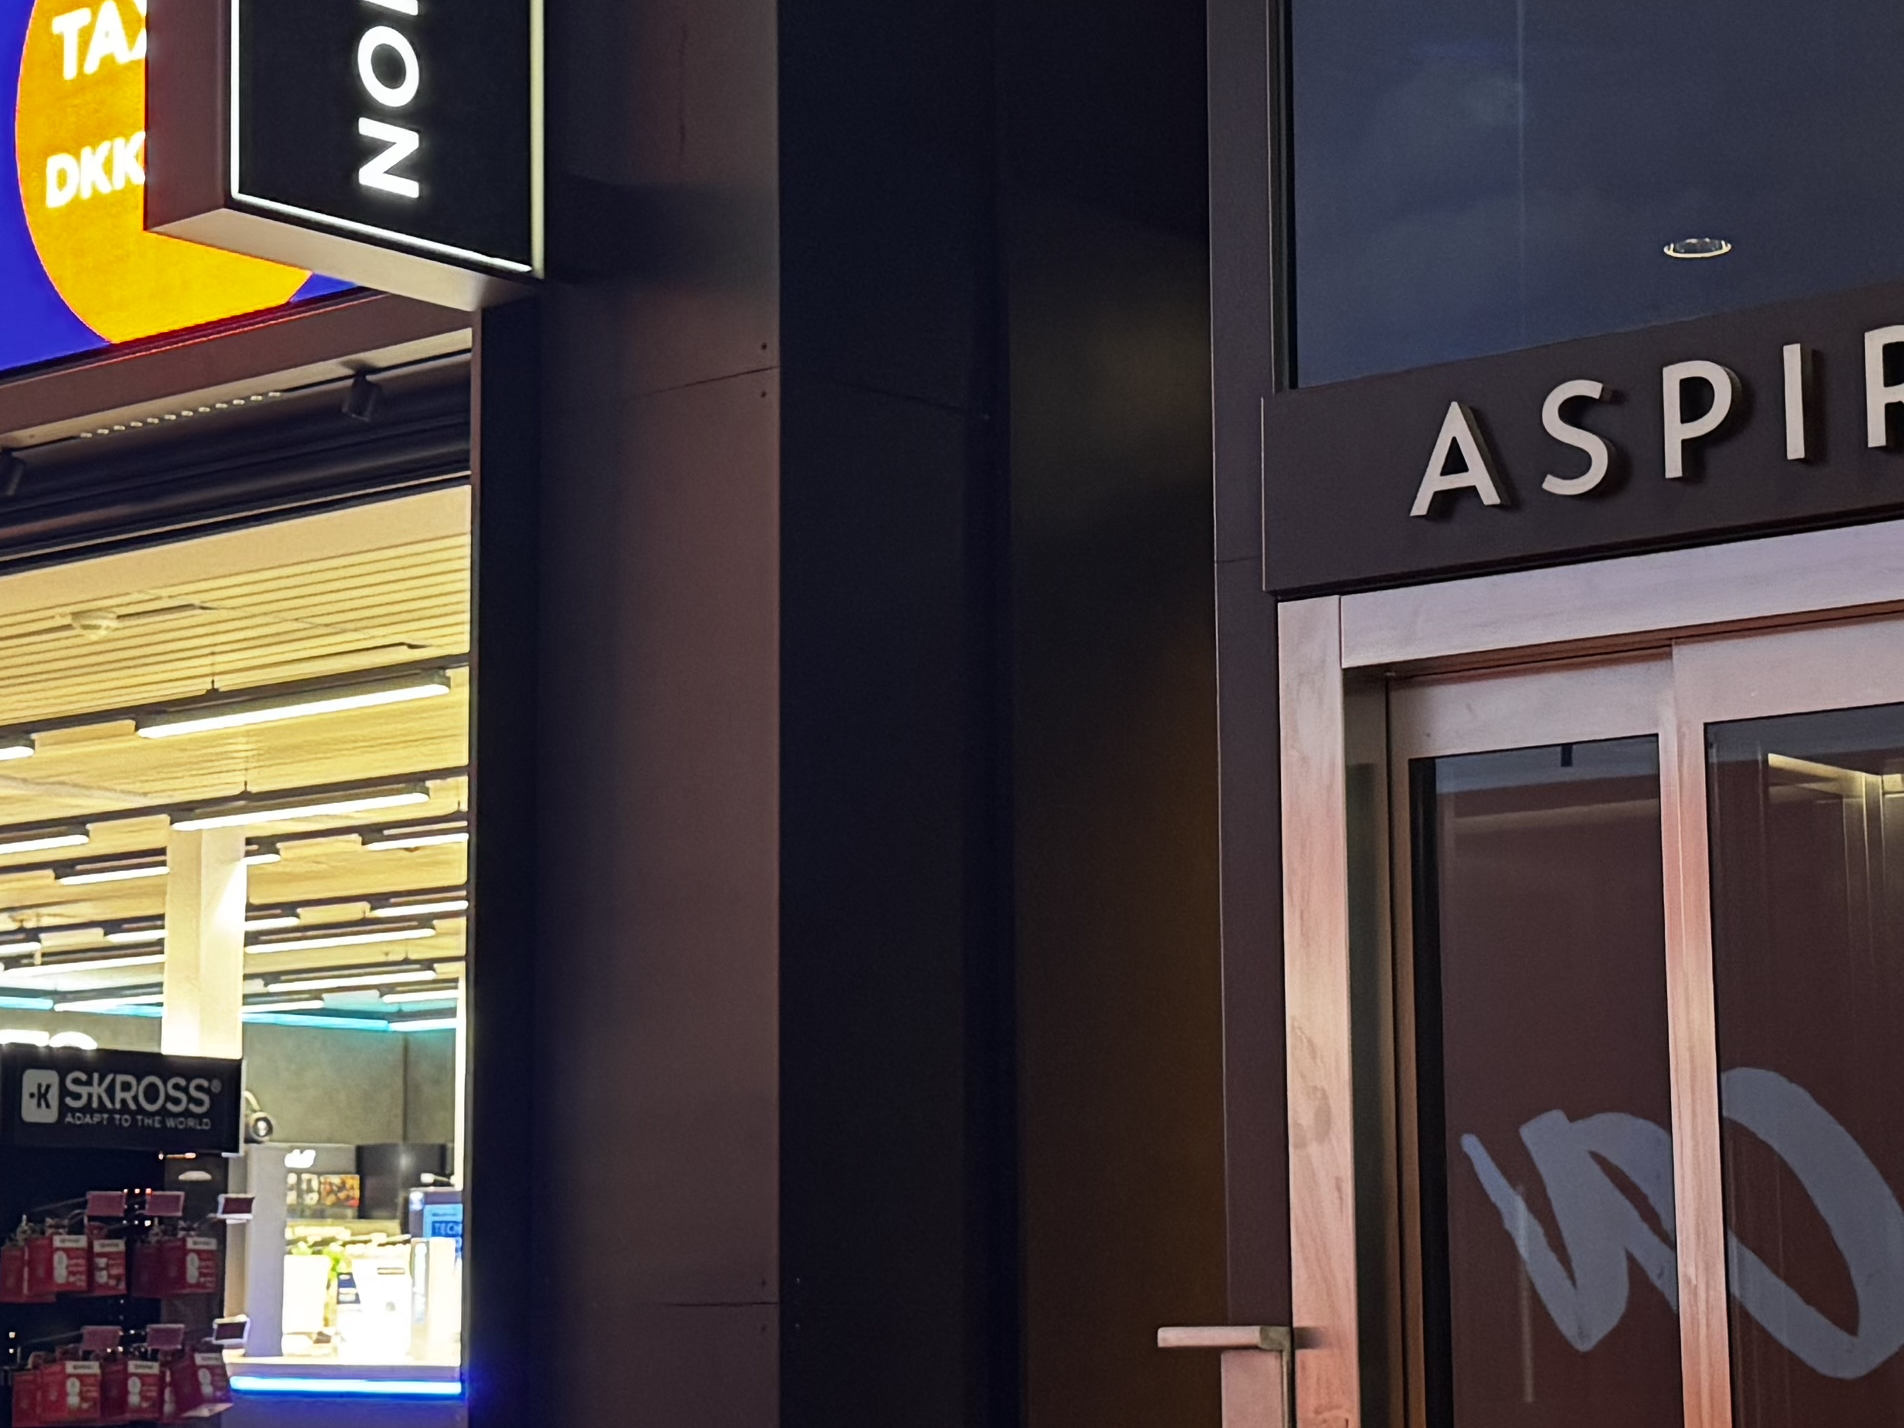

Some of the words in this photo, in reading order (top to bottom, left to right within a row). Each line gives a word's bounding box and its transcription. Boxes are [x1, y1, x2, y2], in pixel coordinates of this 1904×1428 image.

[64, 1113, 109, 1125] ADAPT
[113, 1115, 132, 1127] TO
[136, 1115, 162, 1128] THE
[165, 1117, 212, 1130] WORLD
